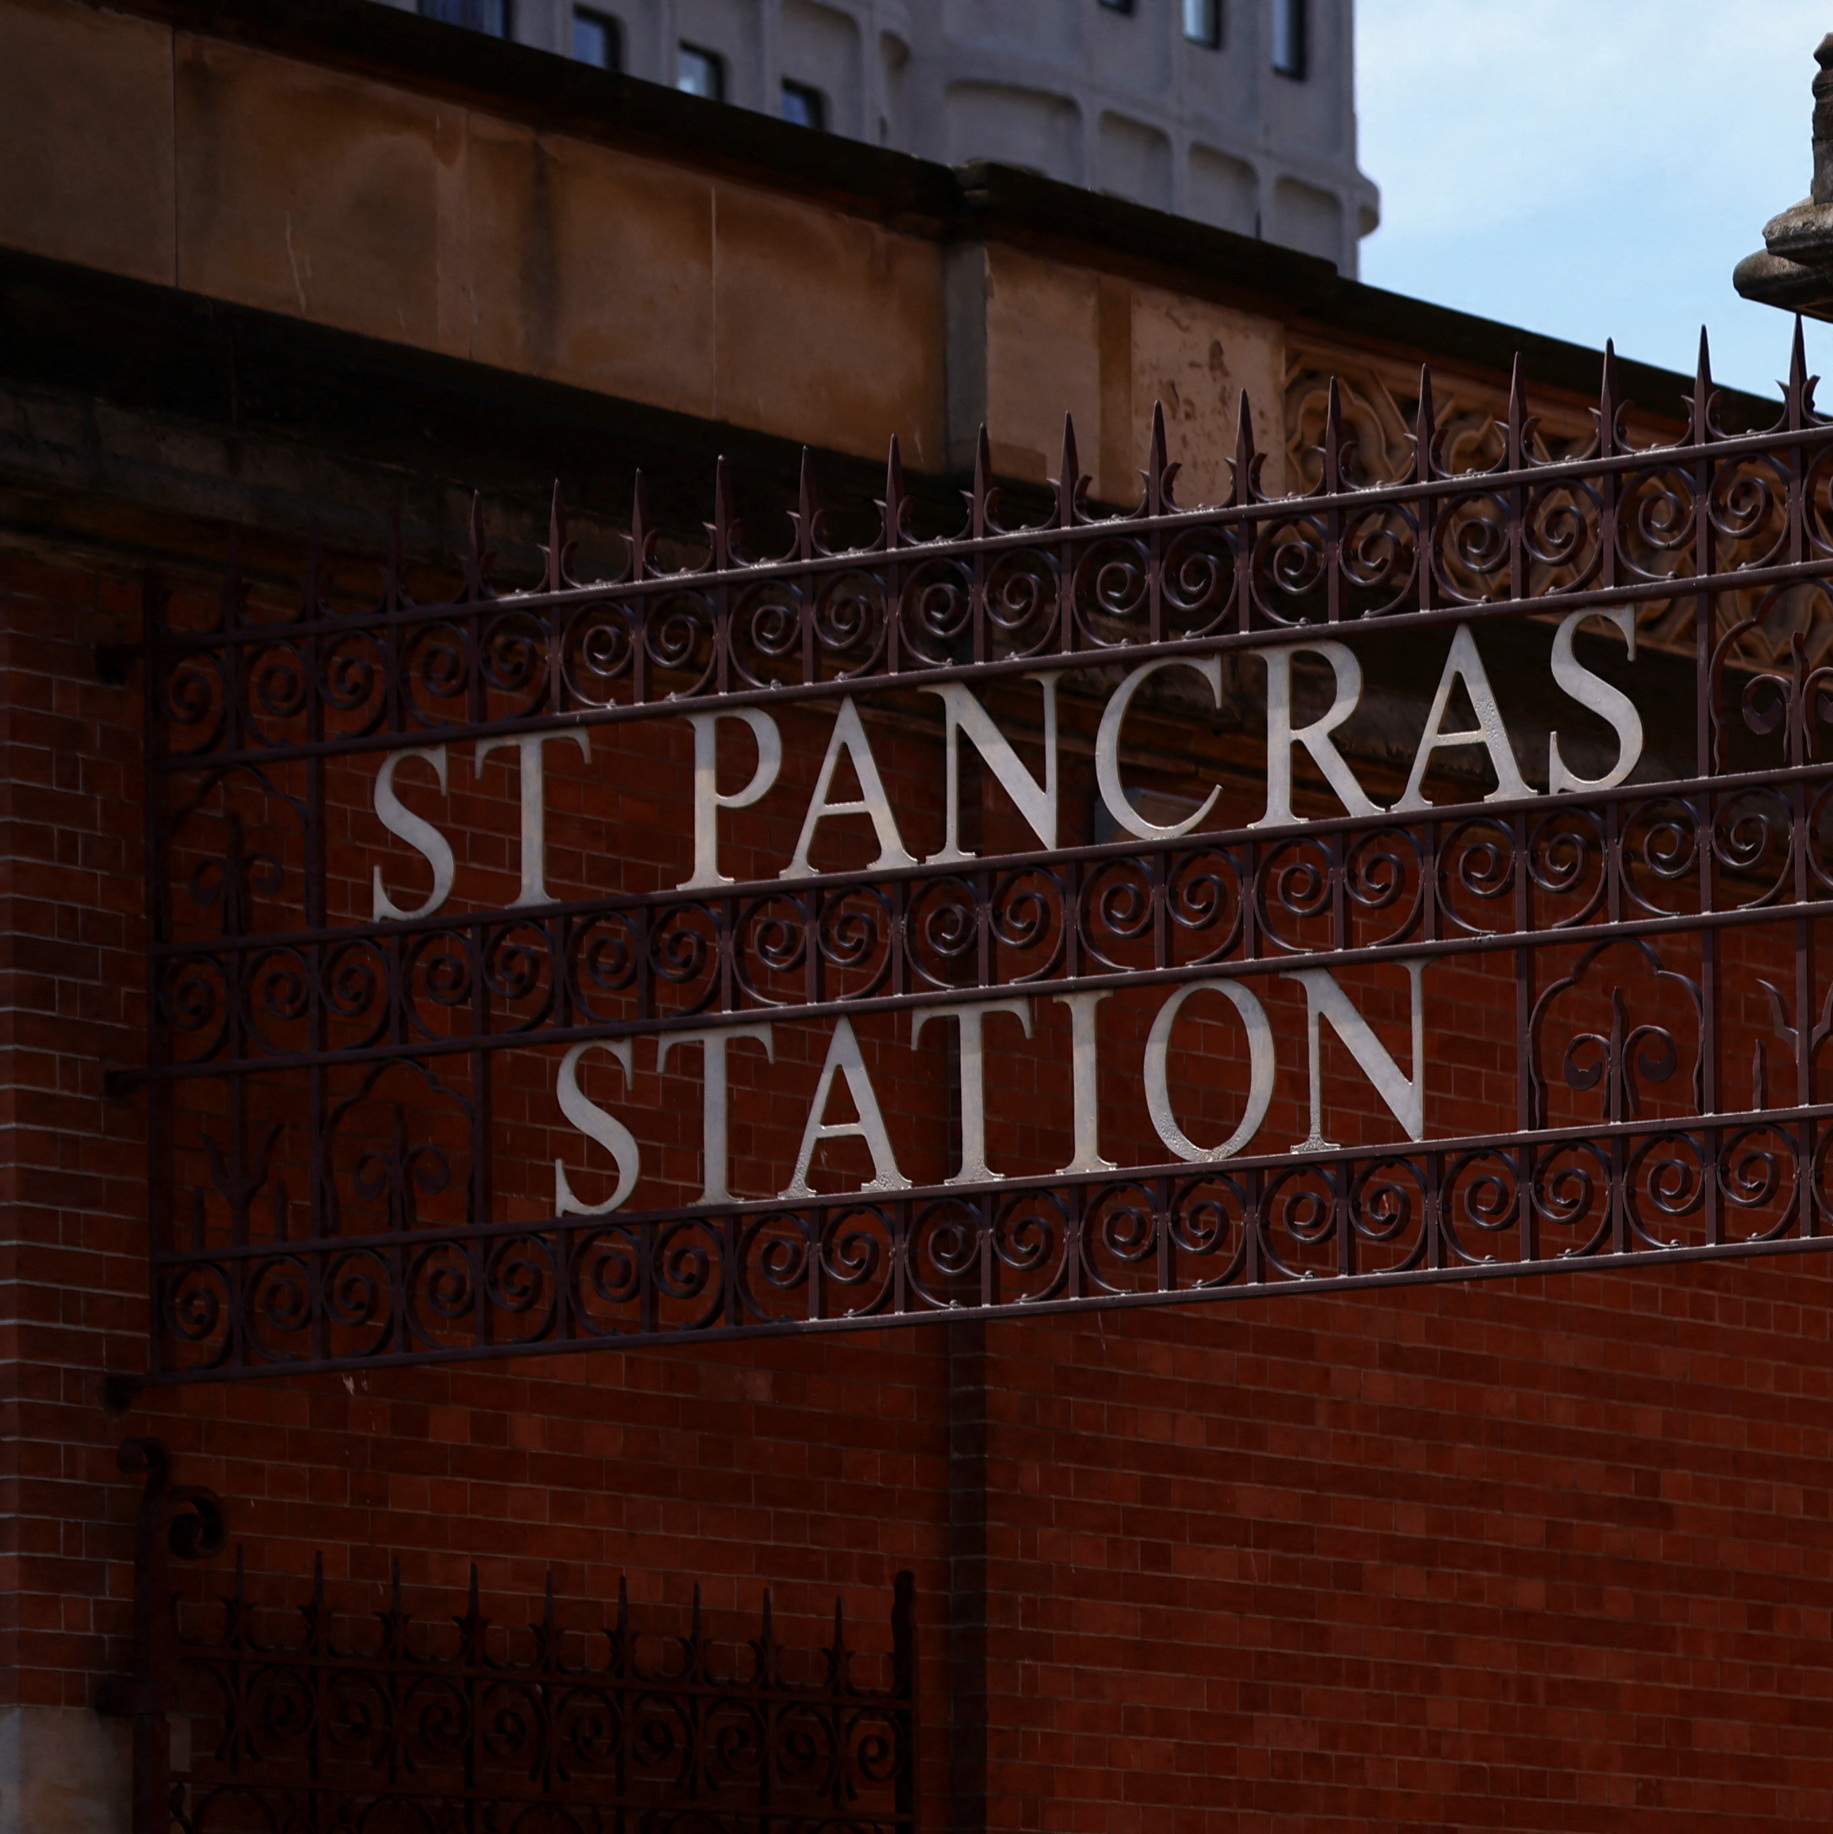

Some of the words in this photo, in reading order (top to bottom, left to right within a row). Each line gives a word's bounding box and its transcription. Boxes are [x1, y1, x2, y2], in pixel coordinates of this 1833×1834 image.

[372, 727, 593, 923] ST
[674, 602, 1646, 892] PANCRAS
[553, 958, 1428, 1218] STATION
